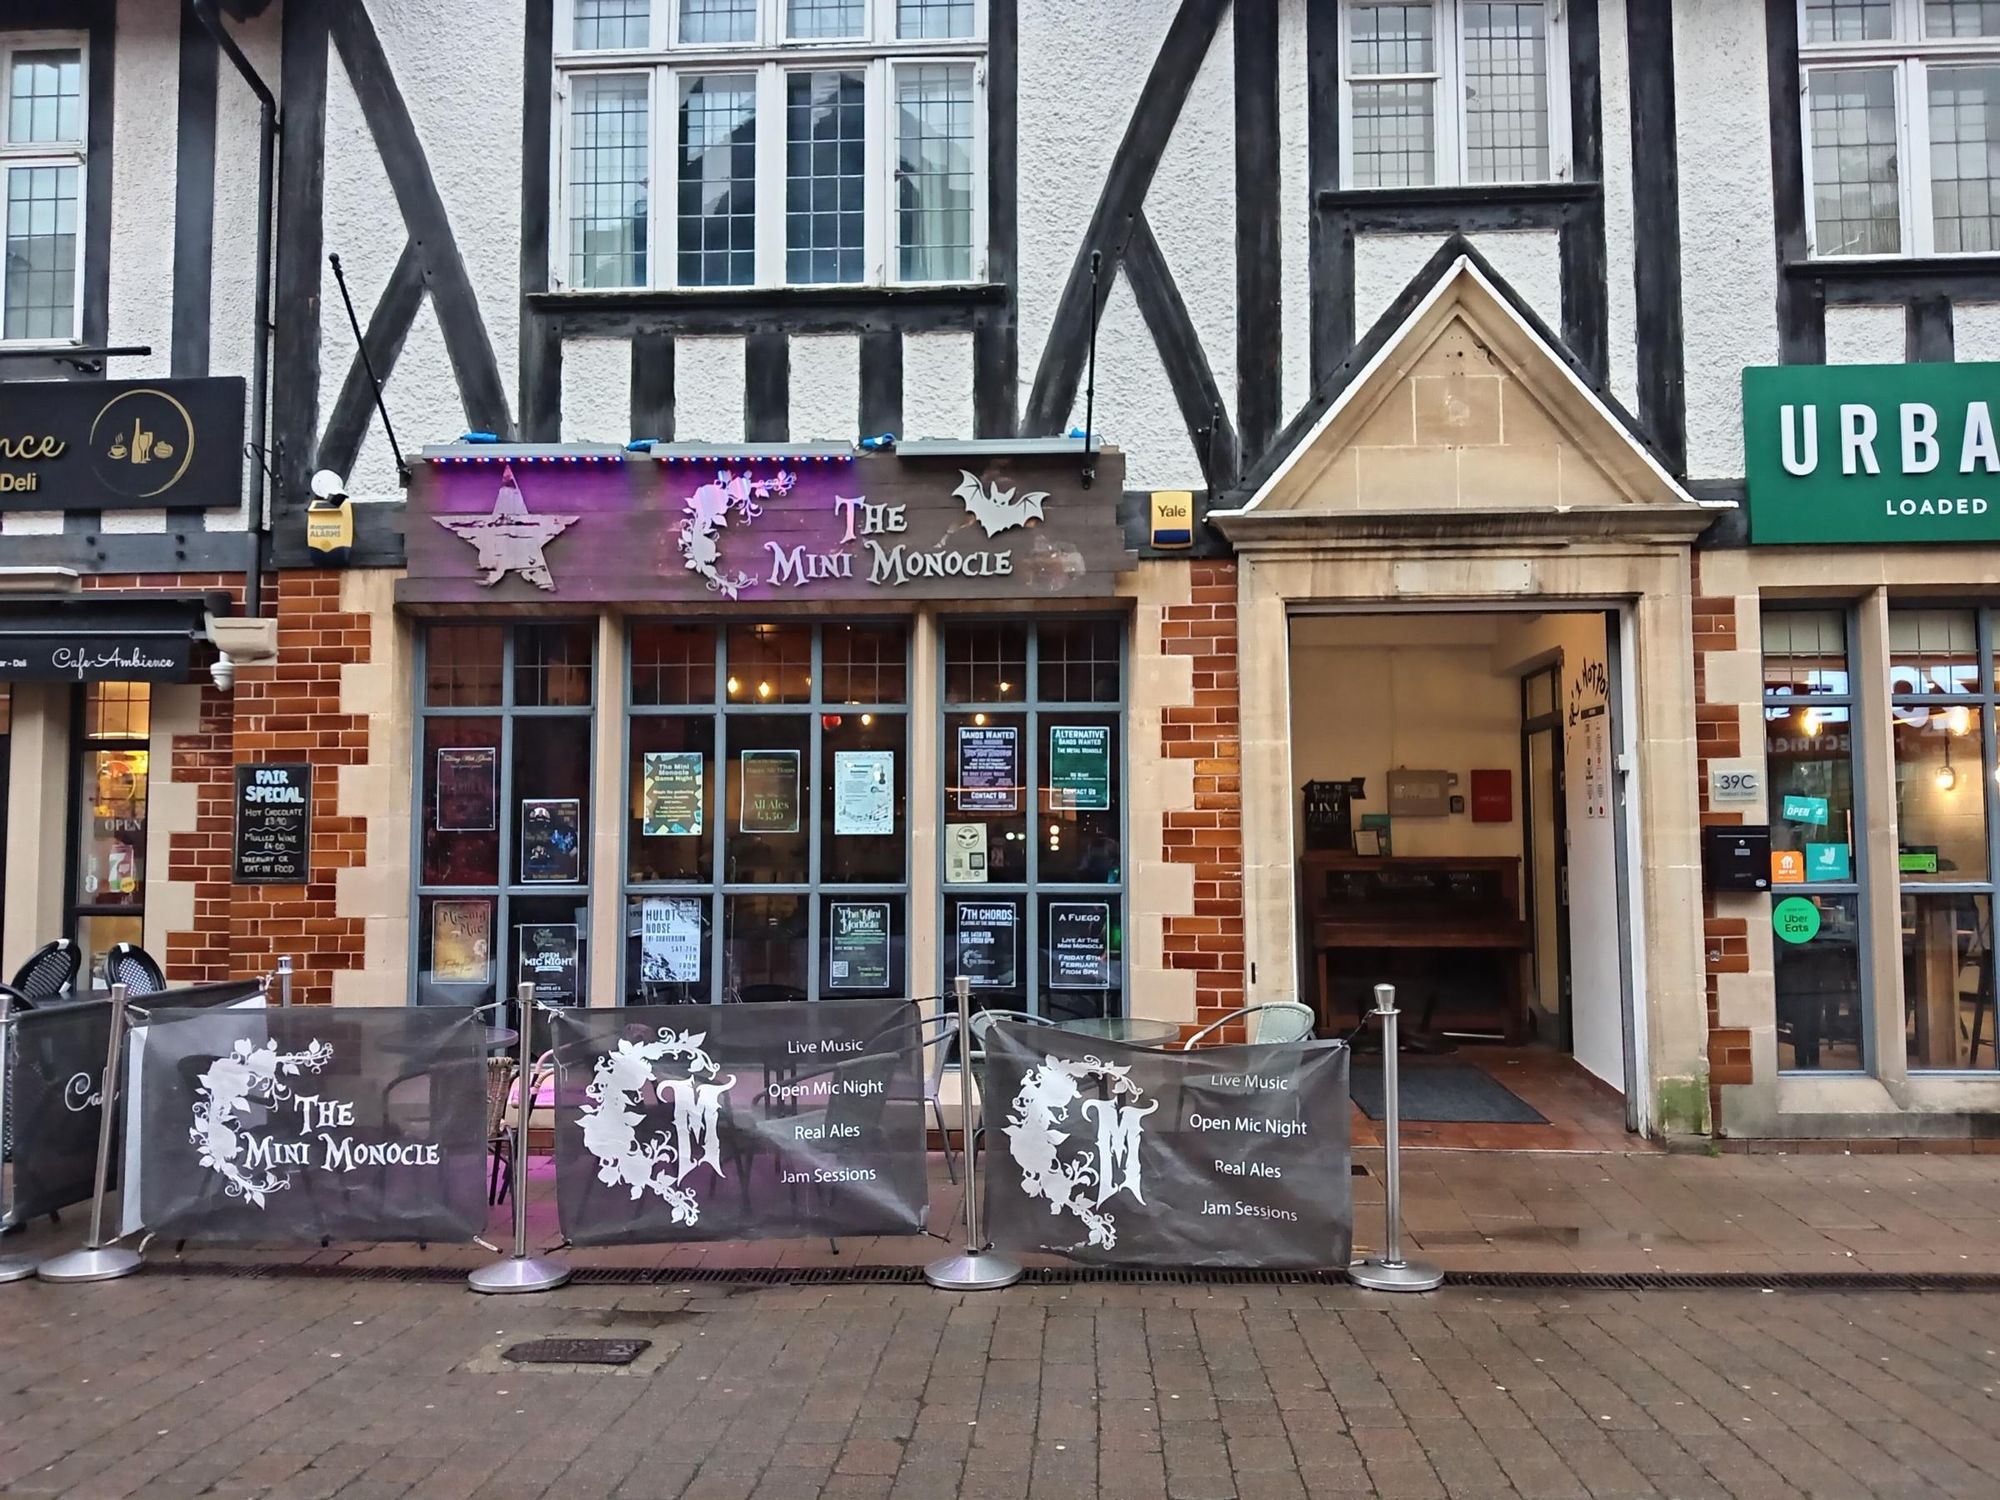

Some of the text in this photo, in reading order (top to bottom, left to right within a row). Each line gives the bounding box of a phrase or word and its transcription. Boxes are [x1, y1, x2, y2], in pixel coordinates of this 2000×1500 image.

[1780, 402, 2000, 476] URBA
[0, 472, 37, 491] Deli
[1157, 504, 1187, 518] Yale
[1886, 499, 1988, 516] LOADED
[835, 495, 907, 544] THE
[764, 540, 1013, 587] MINI MONOCLE
[52, 647, 175, 679] Cafe-Ambience
[962, 730, 1015, 739] BANDS WANTED
[1055, 730, 1105, 739] ALTERNATIVE
[255, 769, 289, 785] FAIR
[1721, 774, 1757, 789] 39C
[245, 785, 305, 803] SPECIAL
[245, 807, 303, 817] HOT CHOCOLATE
[754, 800, 790, 810] All Ales
[1786, 807, 1811, 817] OPEN
[104, 819, 142, 831] OPEN
[244, 833, 297, 843] MULLED WINE
[278, 855, 289, 863] OR
[274, 864, 295, 873] FOOD
[960, 907, 1013, 920] 7TH CHORDS
[645, 923, 672, 934] NOOSE
[1785, 924, 1809, 932] Eats
[524, 958, 574, 966] MIC NIGHT
[539, 952, 560, 960] OPEN
[788, 1039, 864, 1055] Live Music
[768, 1080, 884, 1099] Open Mic Night
[1211, 1073, 1289, 1090] Live Music
[294, 1094, 355, 1136] THE
[794, 1123, 861, 1140] Real Ales
[1189, 1113, 1308, 1137] Open Mic Night
[240, 1133, 440, 1172] MINI MONOCLE
[780, 1168, 877, 1184] Jam Sessions
[1214, 1159, 1282, 1179] Real Ales
[1201, 1200, 1299, 1222] Jam Sessions
